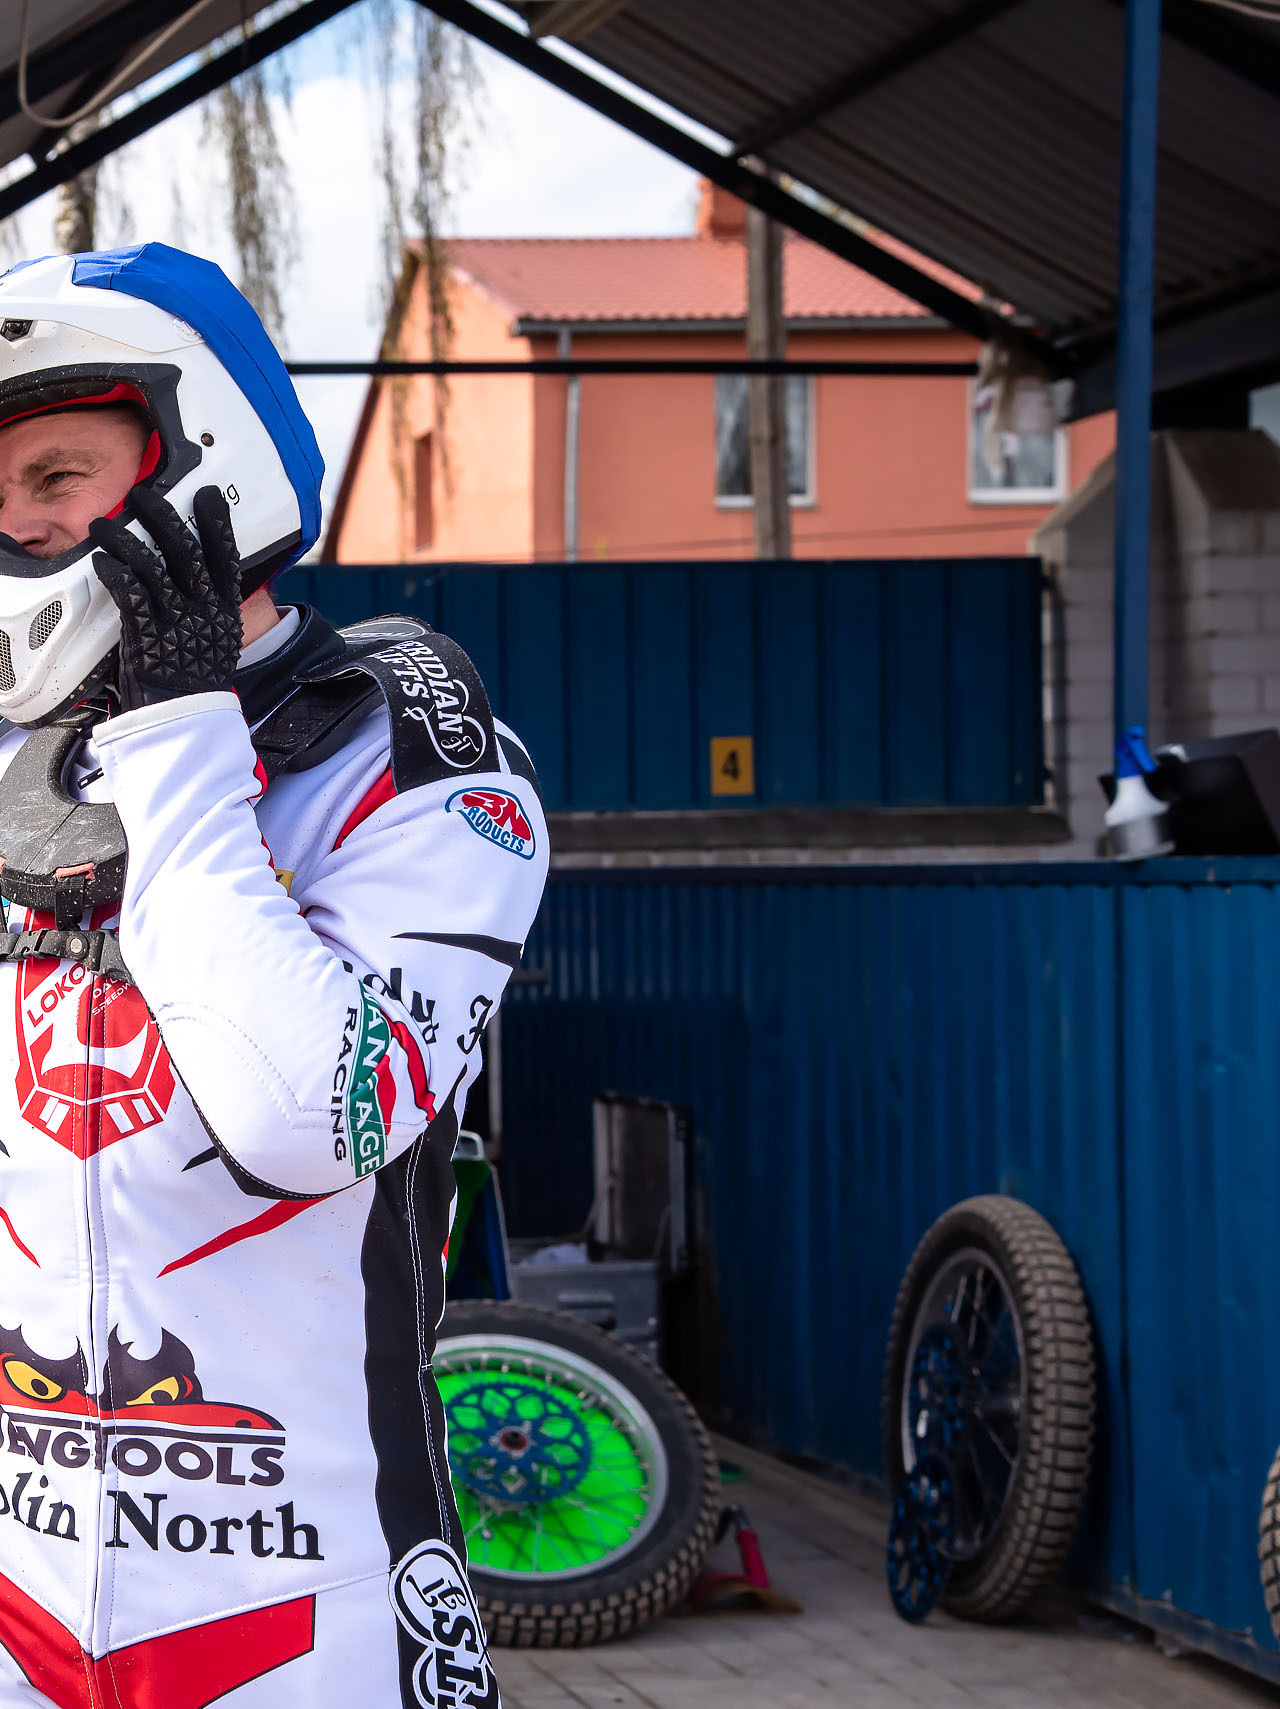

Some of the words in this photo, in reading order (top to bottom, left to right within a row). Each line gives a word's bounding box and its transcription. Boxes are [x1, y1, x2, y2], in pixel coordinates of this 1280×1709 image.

[387, 640, 464, 733] ERIDIAN
[722, 750, 740, 781] 4
[463, 806, 526, 852] RODUCTS
[26, 962, 91, 1028] LOKO
[330, 1006, 358, 1162] RACING
[104, 1490, 325, 1561] North
